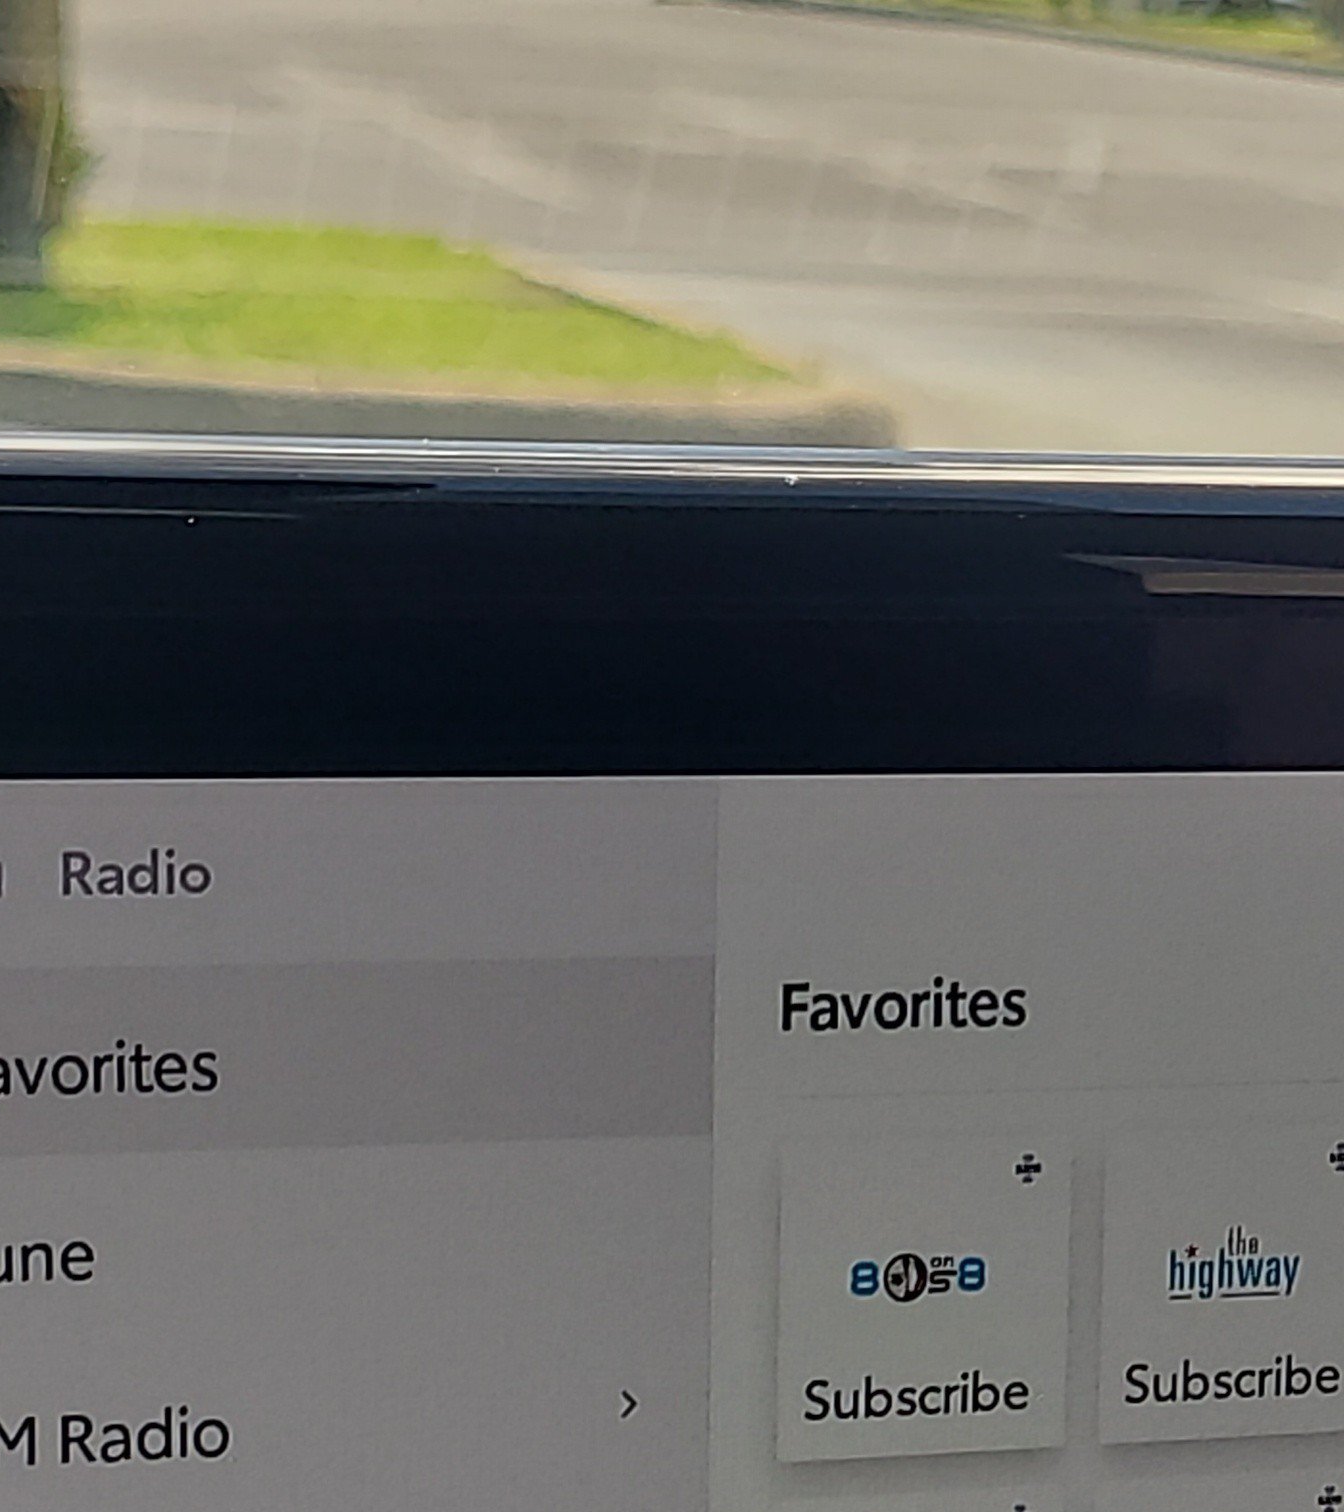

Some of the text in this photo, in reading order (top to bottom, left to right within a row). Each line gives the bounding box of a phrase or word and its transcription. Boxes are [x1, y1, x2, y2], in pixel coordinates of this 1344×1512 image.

[60, 847, 213, 898] Radio
[780, 975, 1028, 1033] Favorites
[1227, 1225, 1260, 1257] the
[1168, 1243, 1300, 1300] highway
[803, 1368, 1030, 1422] Subscribe
[1124, 1353, 1341, 1406] Subscribe
[59, 1404, 232, 1465] Radio
